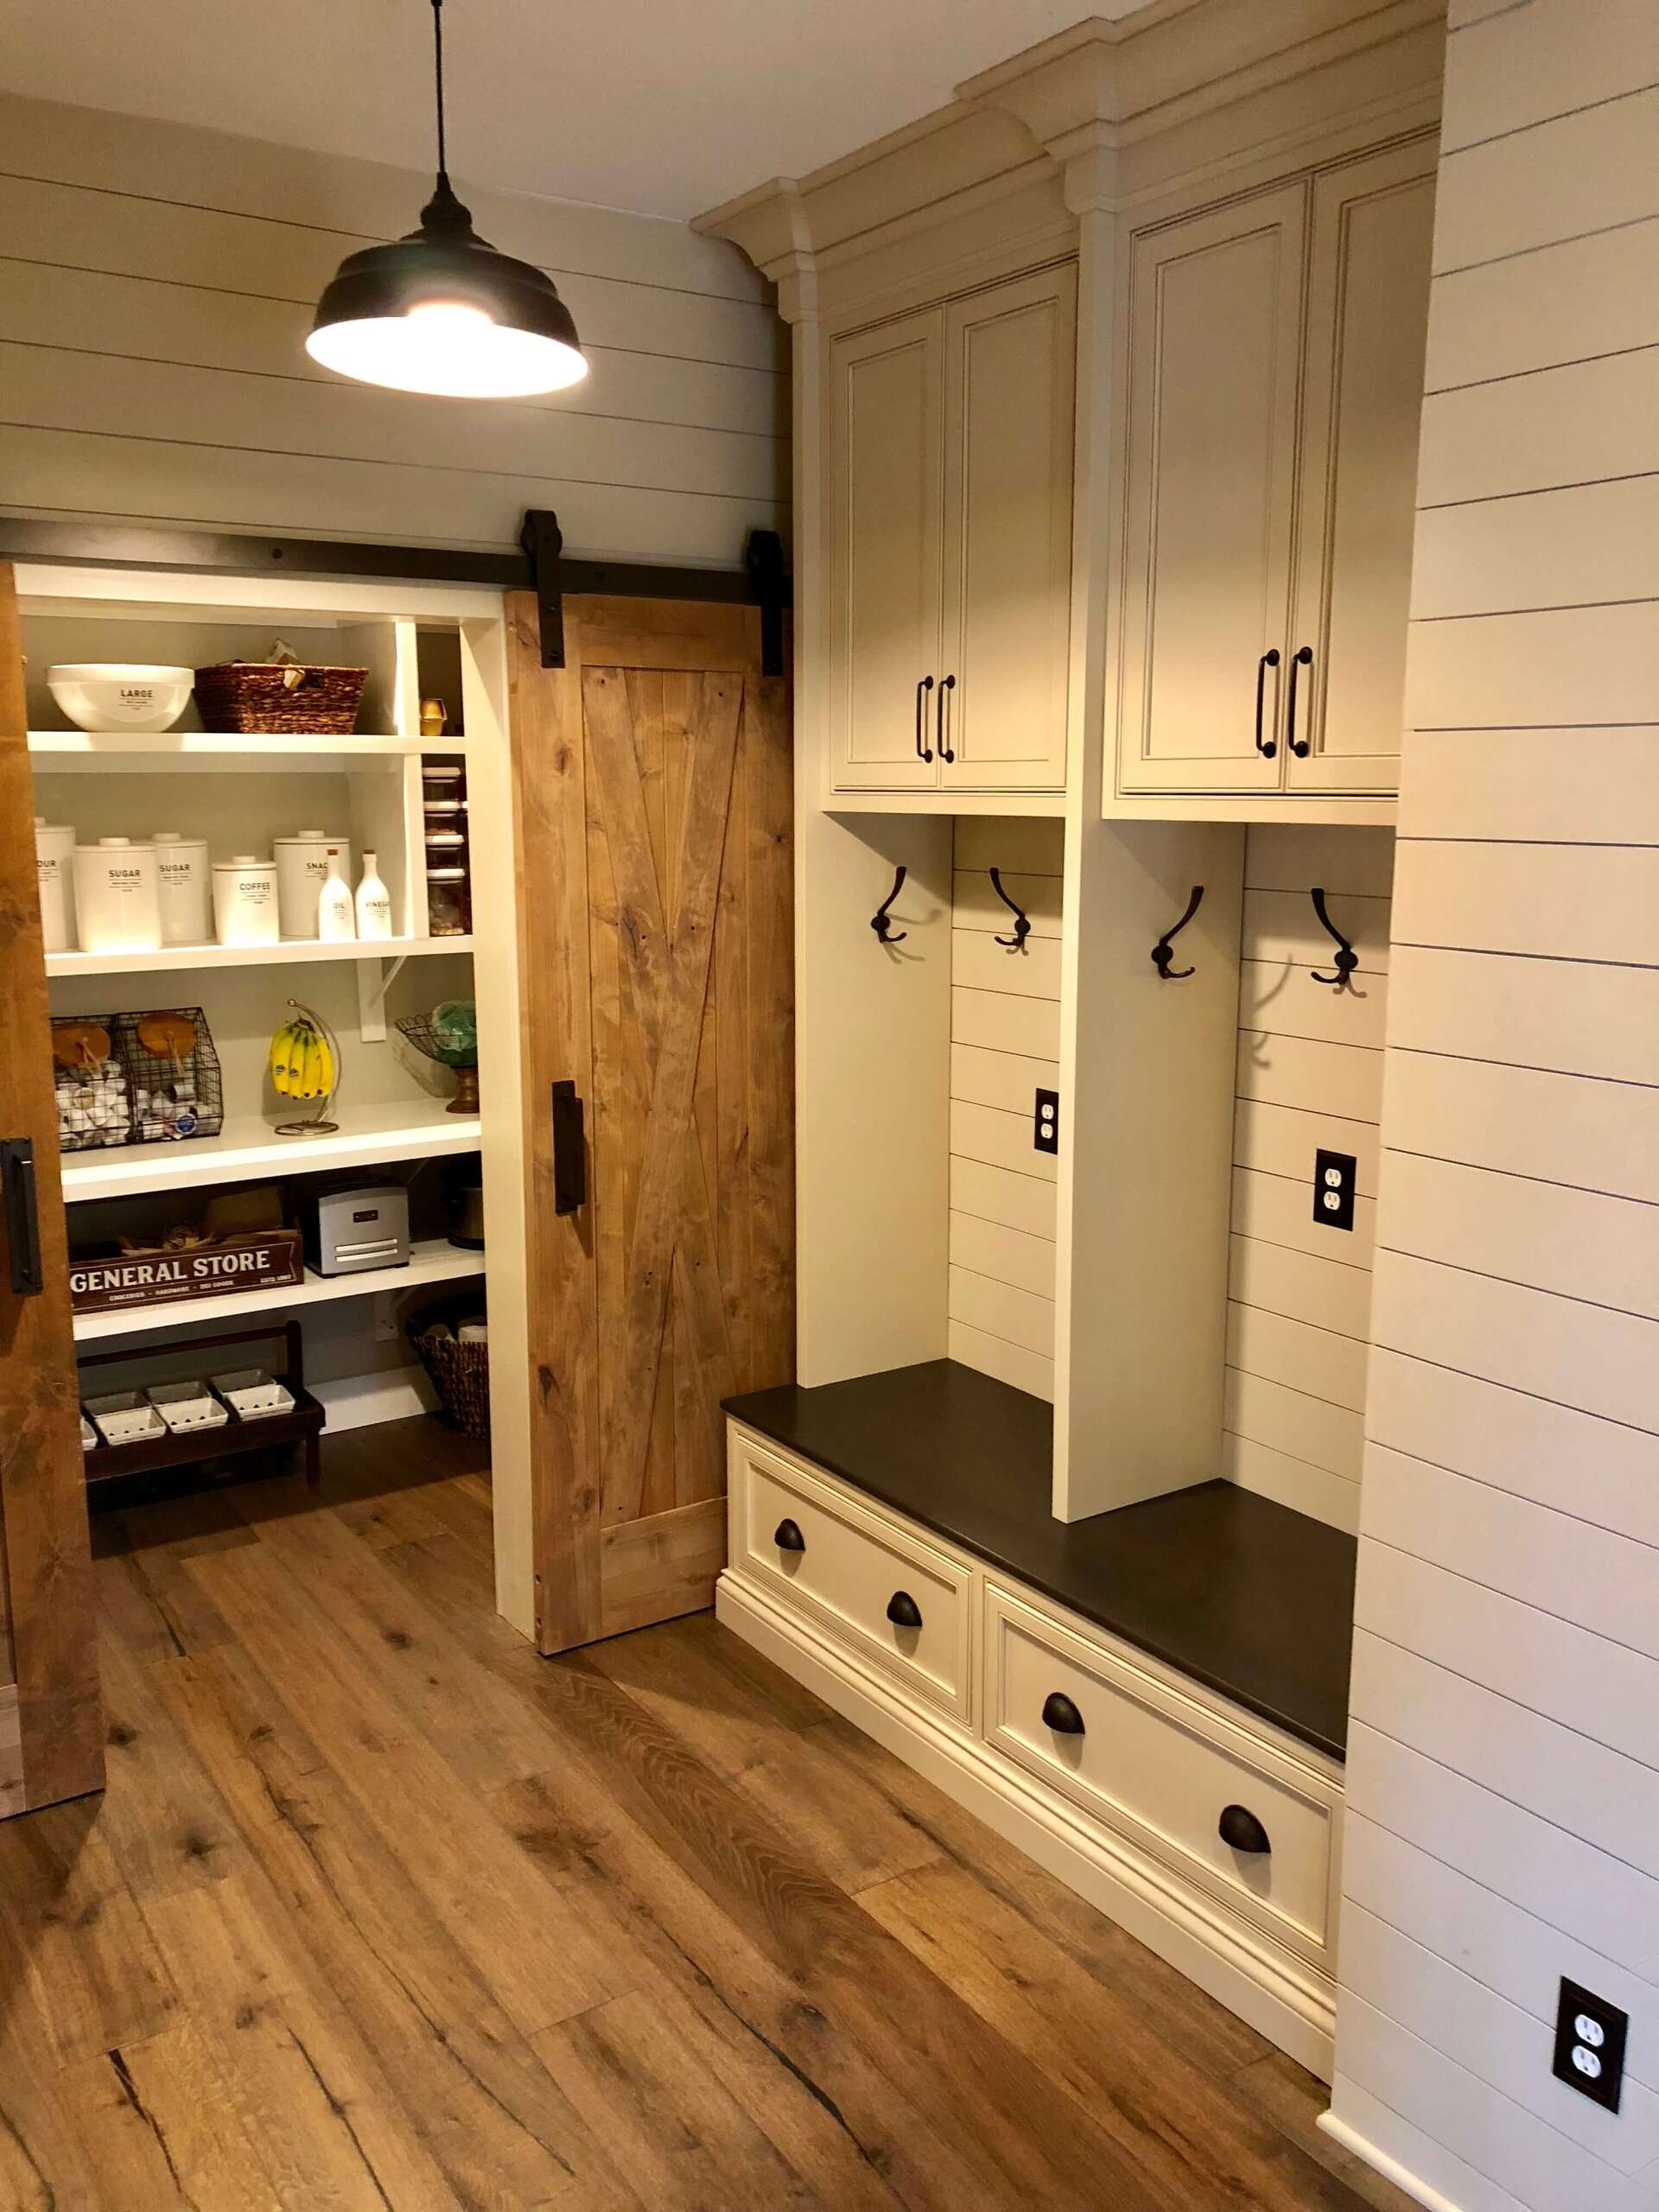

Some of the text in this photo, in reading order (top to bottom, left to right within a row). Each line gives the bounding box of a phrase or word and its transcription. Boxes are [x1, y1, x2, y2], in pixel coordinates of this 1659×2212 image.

[120, 689, 153, 698] LARGE
[239, 881, 270, 891] COFFEE
[70, 1249, 270, 1293] GENERAL STORE
